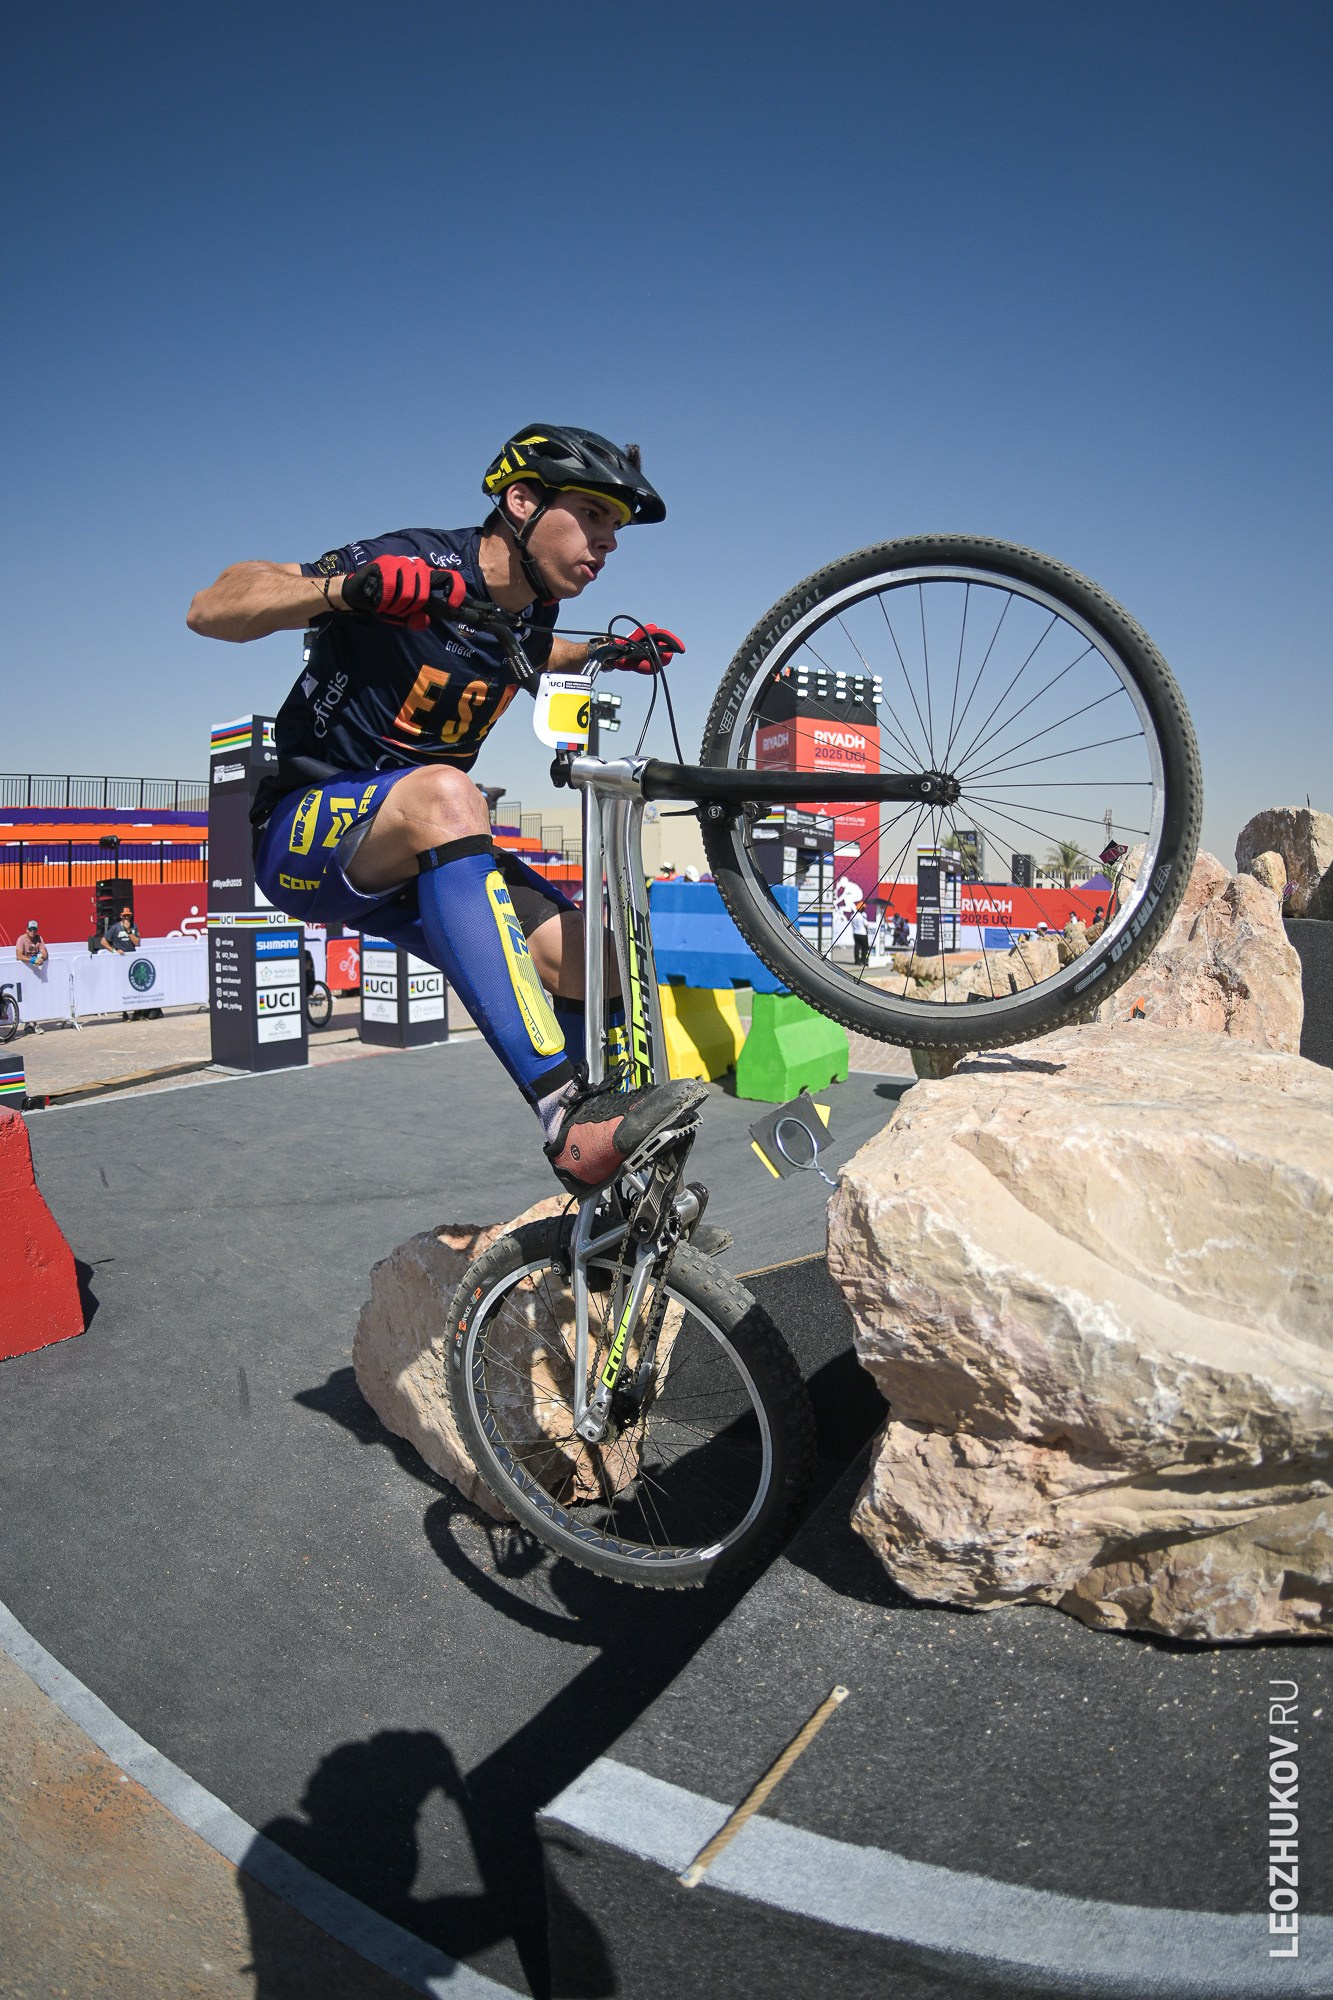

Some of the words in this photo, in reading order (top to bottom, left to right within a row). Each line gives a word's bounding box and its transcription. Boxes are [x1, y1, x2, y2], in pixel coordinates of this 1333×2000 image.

[728, 672, 750, 711] THE
[749, 589, 824, 671] NATIONAL
[577, 701, 590, 729] 6
[763, 733, 788, 751] RIYADH
[814, 730, 866, 749] RIYADH
[815, 747, 842, 760] 2025
[846, 751, 866, 762] UCI
[292, 793, 317, 848] WD-40
[961, 898, 1012, 913] RIYADH
[221, 916, 234, 924] UCI
[268, 915, 286, 923] UCI
[962, 914, 988, 924] 2025
[992, 916, 1012, 925] UCI
[1130, 890, 1160, 938] TIRE
[256, 939, 299, 950] SHIMANO
[370, 980, 393, 994] UCI
[416, 979, 439, 993] UCI
[266, 992, 295, 1009] UCI
